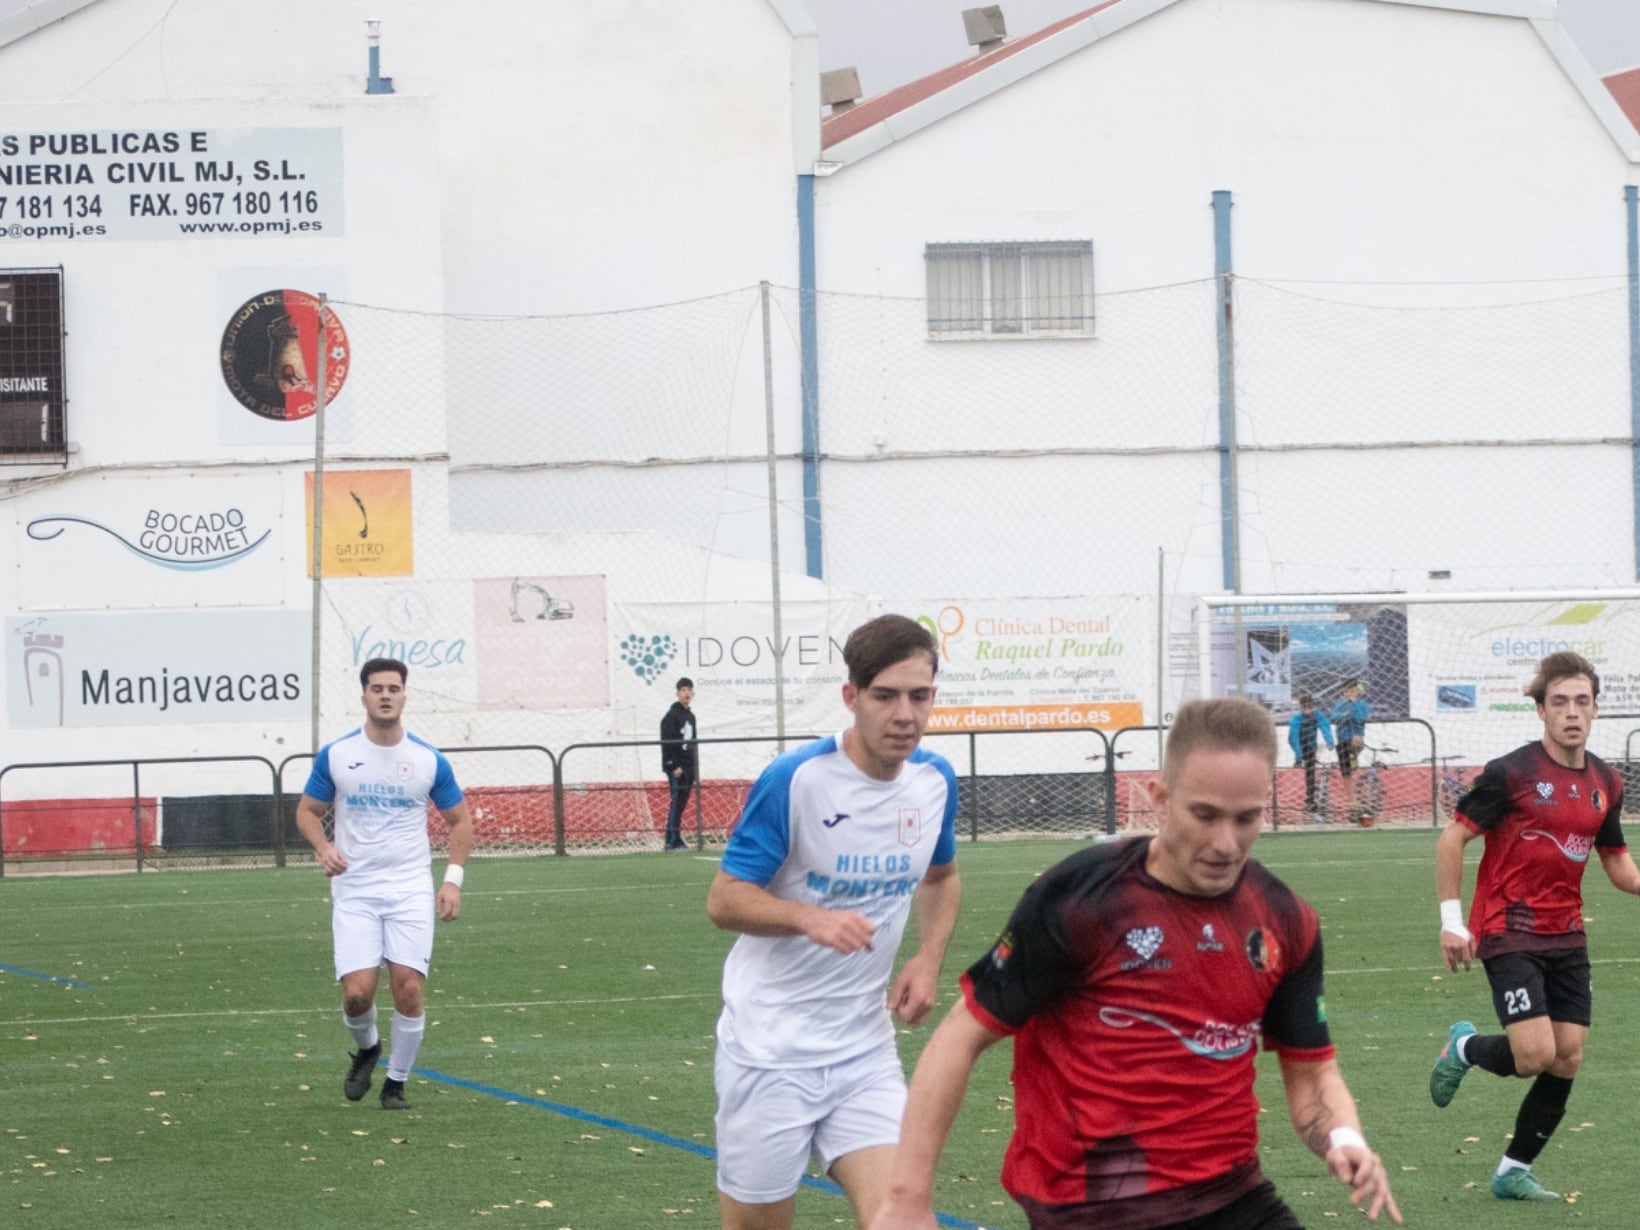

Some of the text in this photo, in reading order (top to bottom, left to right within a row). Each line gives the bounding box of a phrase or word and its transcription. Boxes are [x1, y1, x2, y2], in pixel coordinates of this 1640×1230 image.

[29, 132, 180, 156] PUBLICAS
[190, 131, 208, 153] E
[107, 161, 185, 184] CIVIL
[195, 160, 243, 187] MJ,
[253, 159, 306, 181] S.L.
[16, 194, 52, 219] 181
[63, 193, 102, 218] 134
[130, 192, 178, 217] FAX.
[185, 191, 224, 216] 967
[232, 190, 271, 215] 180
[279, 190, 318, 214] 116
[179, 218, 323, 235] www.opmj.es
[145, 508, 244, 534] BOCADO
[139, 526, 251, 556] GOURMET
[1049, 615, 1111, 635] Dental
[351, 625, 467, 669] Vanesa
[975, 636, 1125, 664] Raquel Pardo
[980, 667, 1032, 681] Dentales
[1034, 667, 1050, 680] de
[1053, 665, 1115, 685] Confianza
[81, 667, 301, 711] Manjavacas
[358, 783, 406, 796] HIELOS
[835, 854, 912, 874] HIELOS
[1504, 987, 1532, 1015] 23
